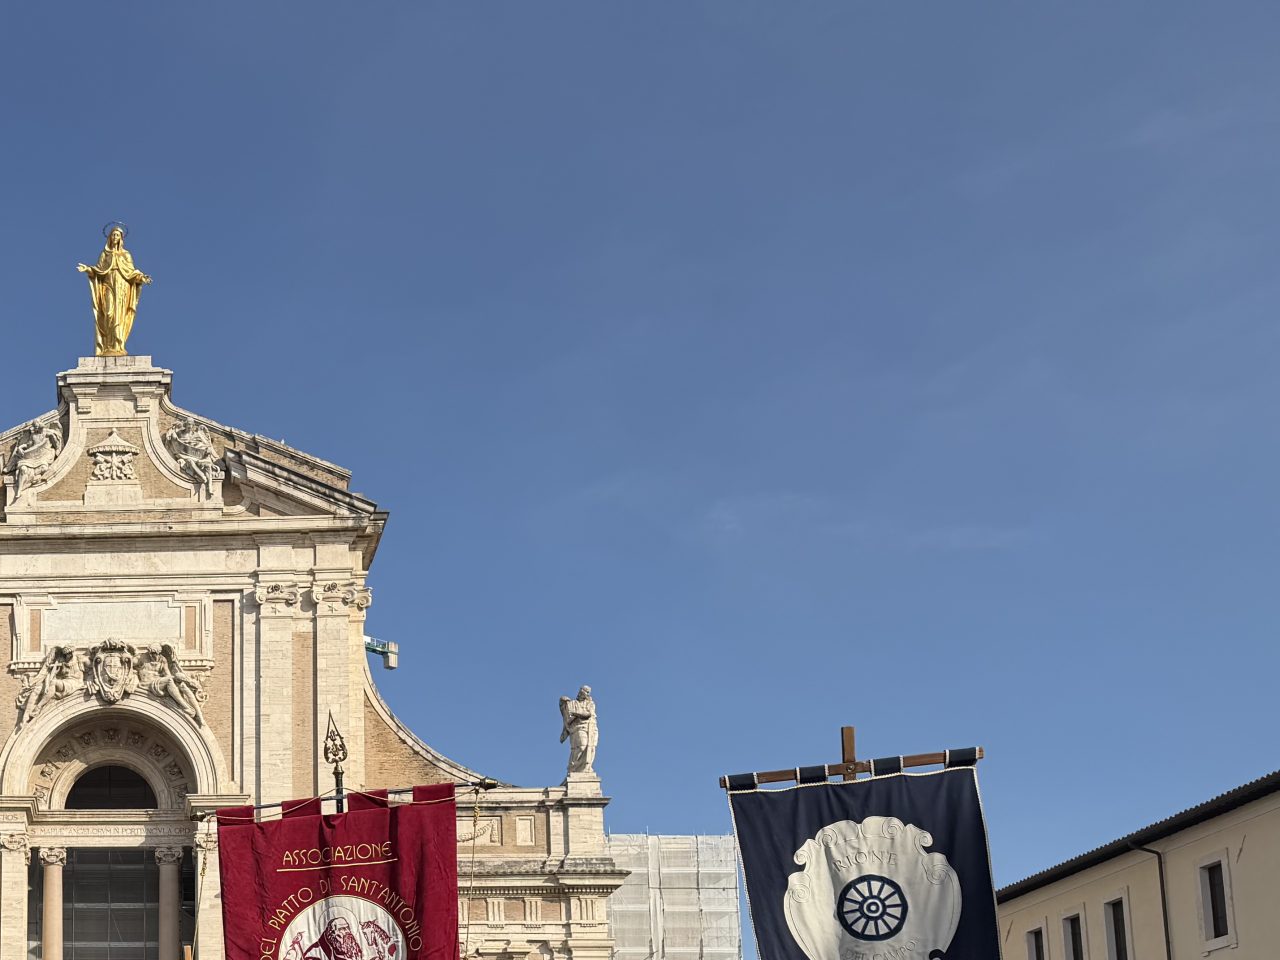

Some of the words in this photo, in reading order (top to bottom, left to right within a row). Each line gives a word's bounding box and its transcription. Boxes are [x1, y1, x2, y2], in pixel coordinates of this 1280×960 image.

[282, 841, 393, 866] ASSOCIAZIONE
[833, 848, 898, 872] RIONE
[269, 887, 313, 931] PIATTO
[319, 879, 332, 894] DI
[340, 875, 423, 951] SANT'ANTONIO
